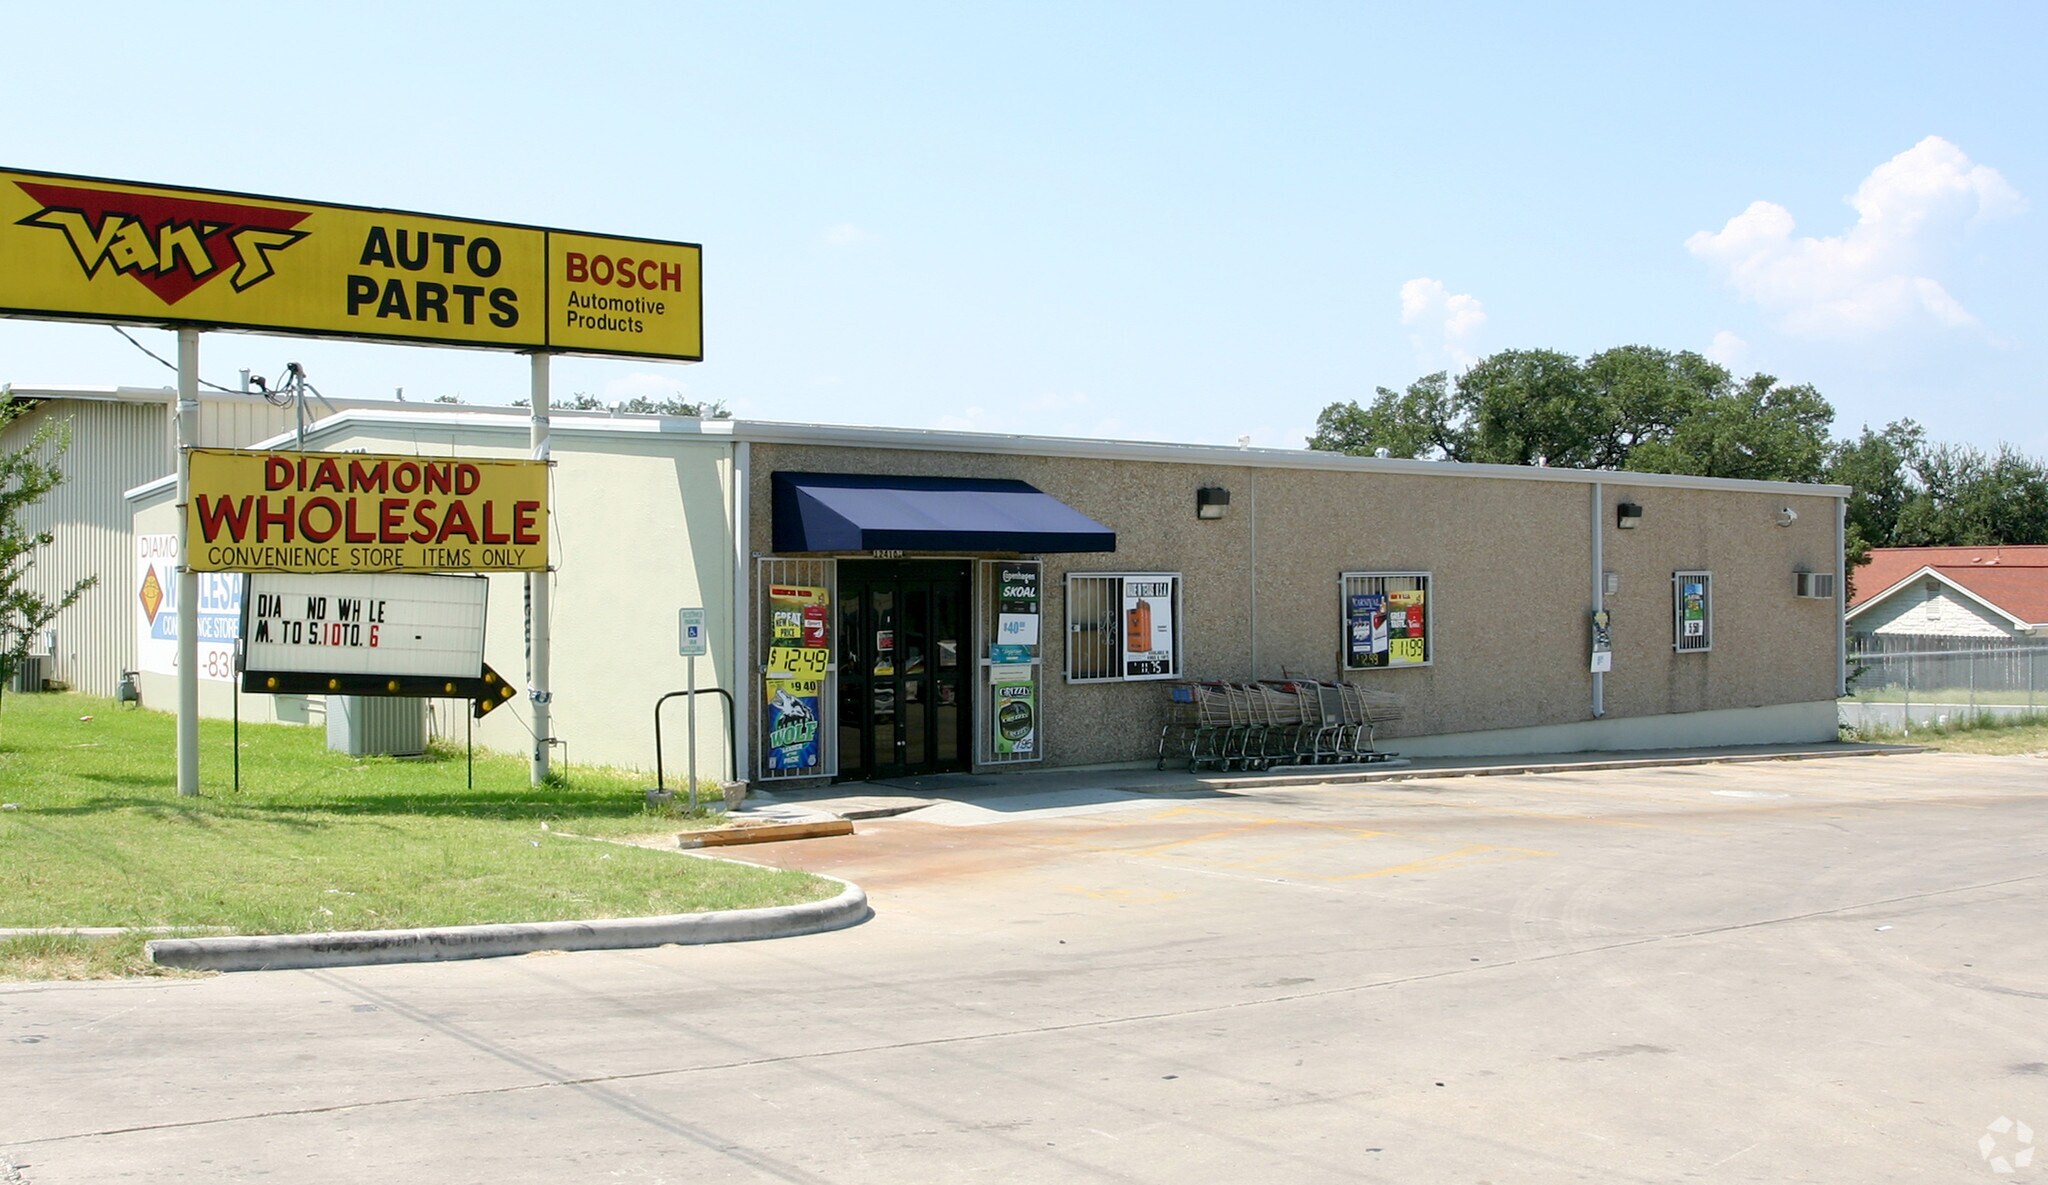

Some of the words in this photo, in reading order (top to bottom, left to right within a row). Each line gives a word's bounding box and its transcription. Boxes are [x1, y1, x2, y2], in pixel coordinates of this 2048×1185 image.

[359, 226, 501, 277] AUTO
[566, 252, 682, 292] BOSCH
[347, 274, 519, 328] PARTS
[568, 290, 665, 315] Automotive
[567, 310, 643, 333] Products
[265, 457, 481, 496] DIAMOND
[195, 494, 541, 545] WHOLESALE
[208, 547, 339, 567] CONVENIENCE
[350, 548, 404, 567] STORE
[422, 548, 471, 567] ITEMS
[482, 549, 526, 567] ONLY
[1002, 570, 1036, 584] Copenhagen
[1002, 586, 1036, 598] SKOAL
[257, 594, 282, 619] DIA
[338, 597, 360, 623] WH
[369, 601, 386, 623] LE
[775, 611, 802, 623] GREAT
[282, 621, 301, 644] TO
[780, 628, 795, 638] PRICE
[770, 721, 817, 749] WOLF
